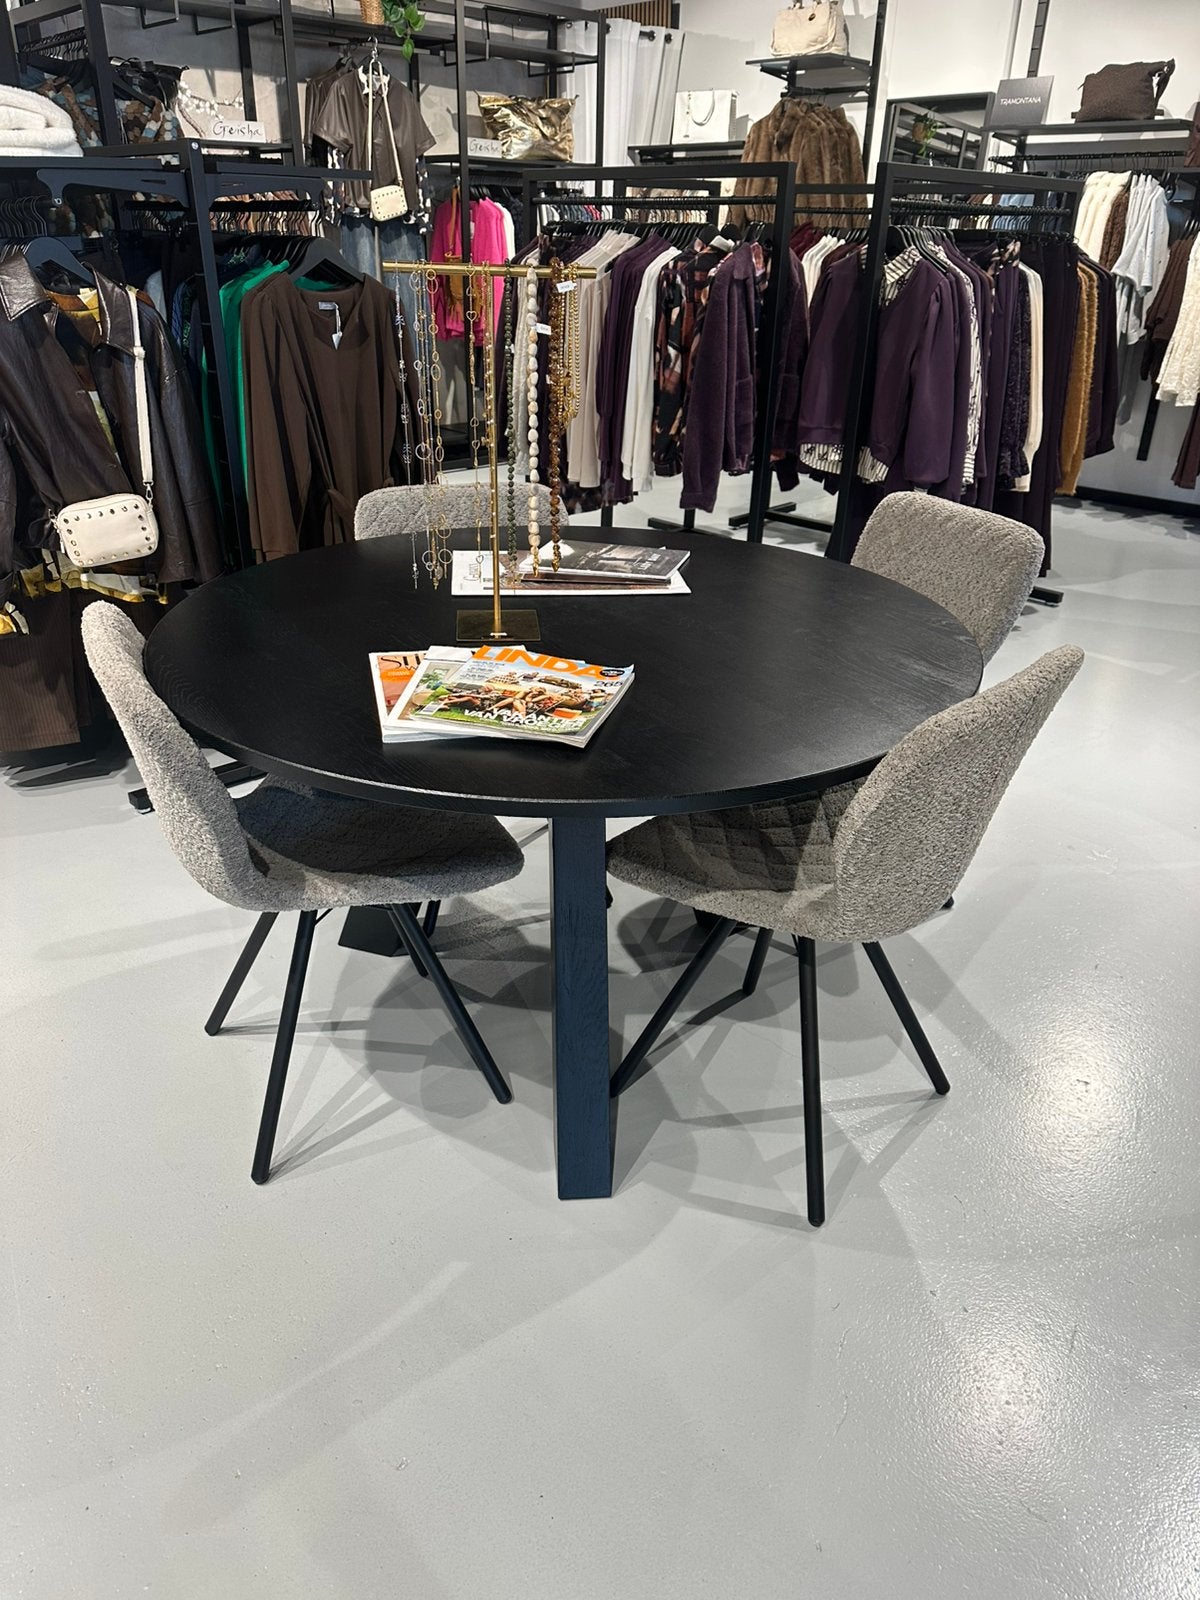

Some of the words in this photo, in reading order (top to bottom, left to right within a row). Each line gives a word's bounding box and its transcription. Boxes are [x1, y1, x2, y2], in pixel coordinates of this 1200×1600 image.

[1000, 96, 1042, 105] TRAMONTANA
[212, 120, 262, 138] Geisha
[464, 708, 498, 720] VAN
